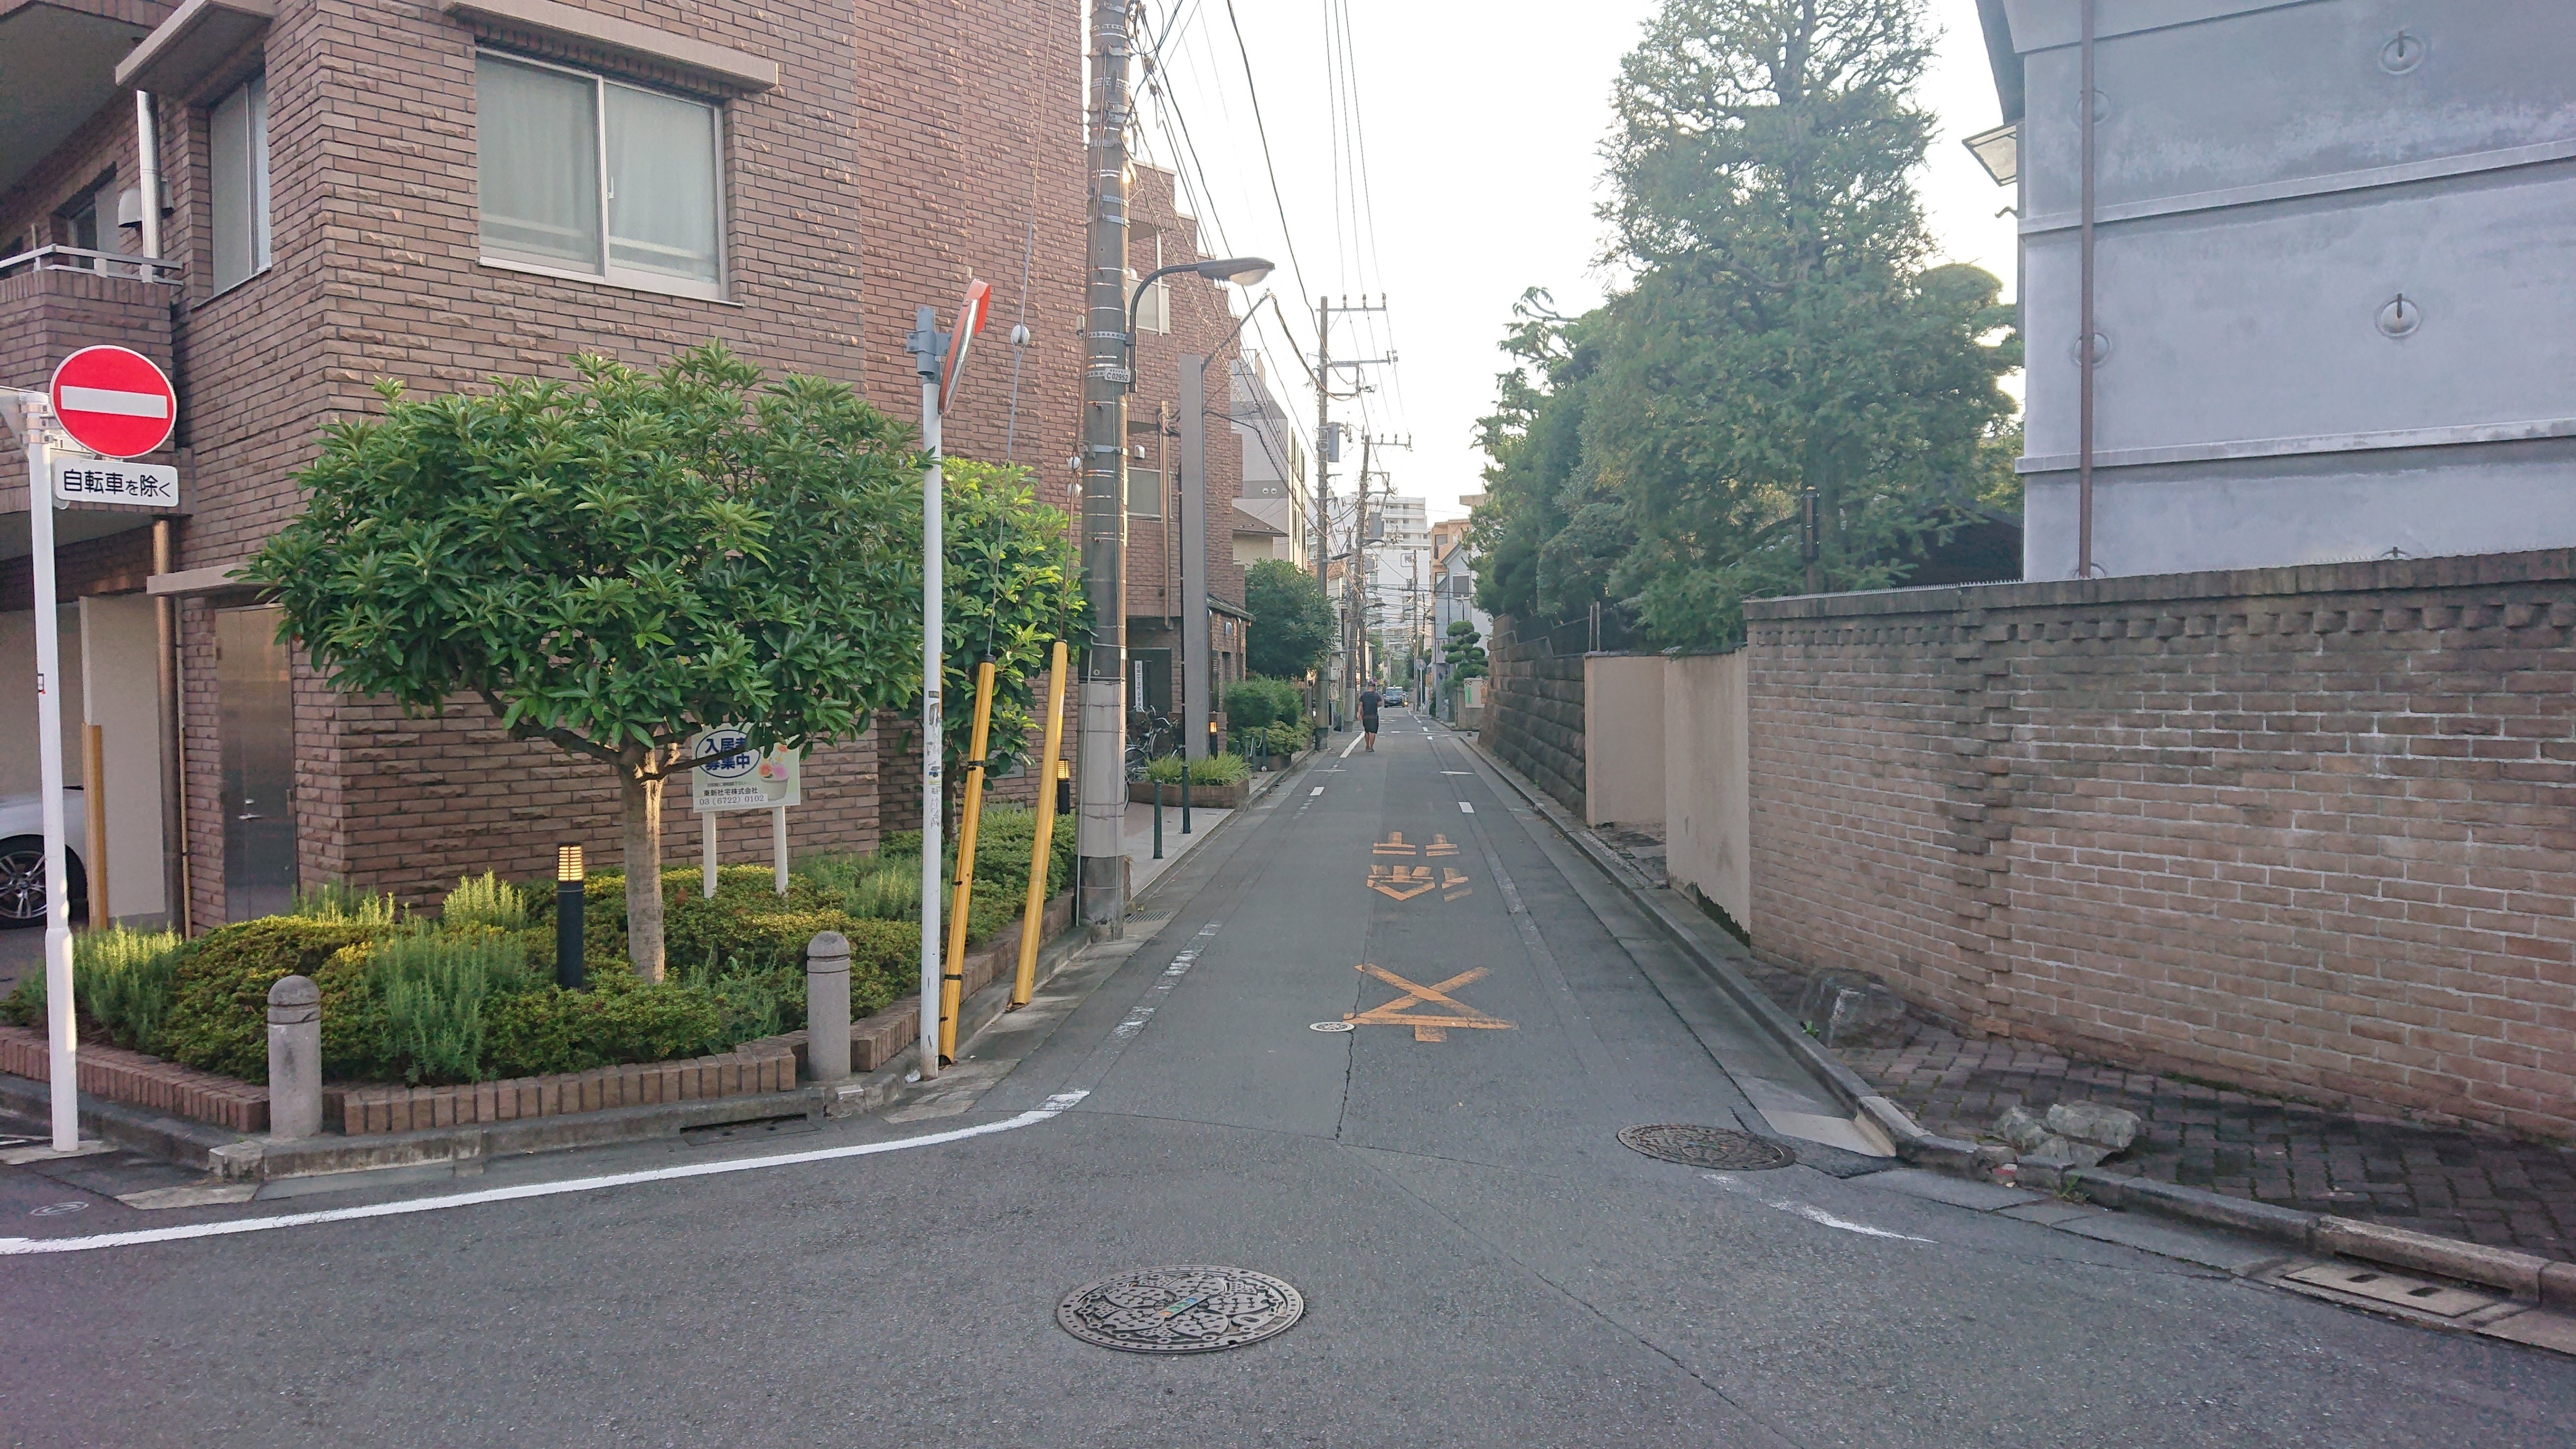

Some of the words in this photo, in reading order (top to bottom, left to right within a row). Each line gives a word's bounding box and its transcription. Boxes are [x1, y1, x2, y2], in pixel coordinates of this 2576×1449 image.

[1107, 372, 1128, 381] C02952
[63, 468, 171, 498] 自転車を除く
[703, 787, 758, 797] 東新社宅株式会社
